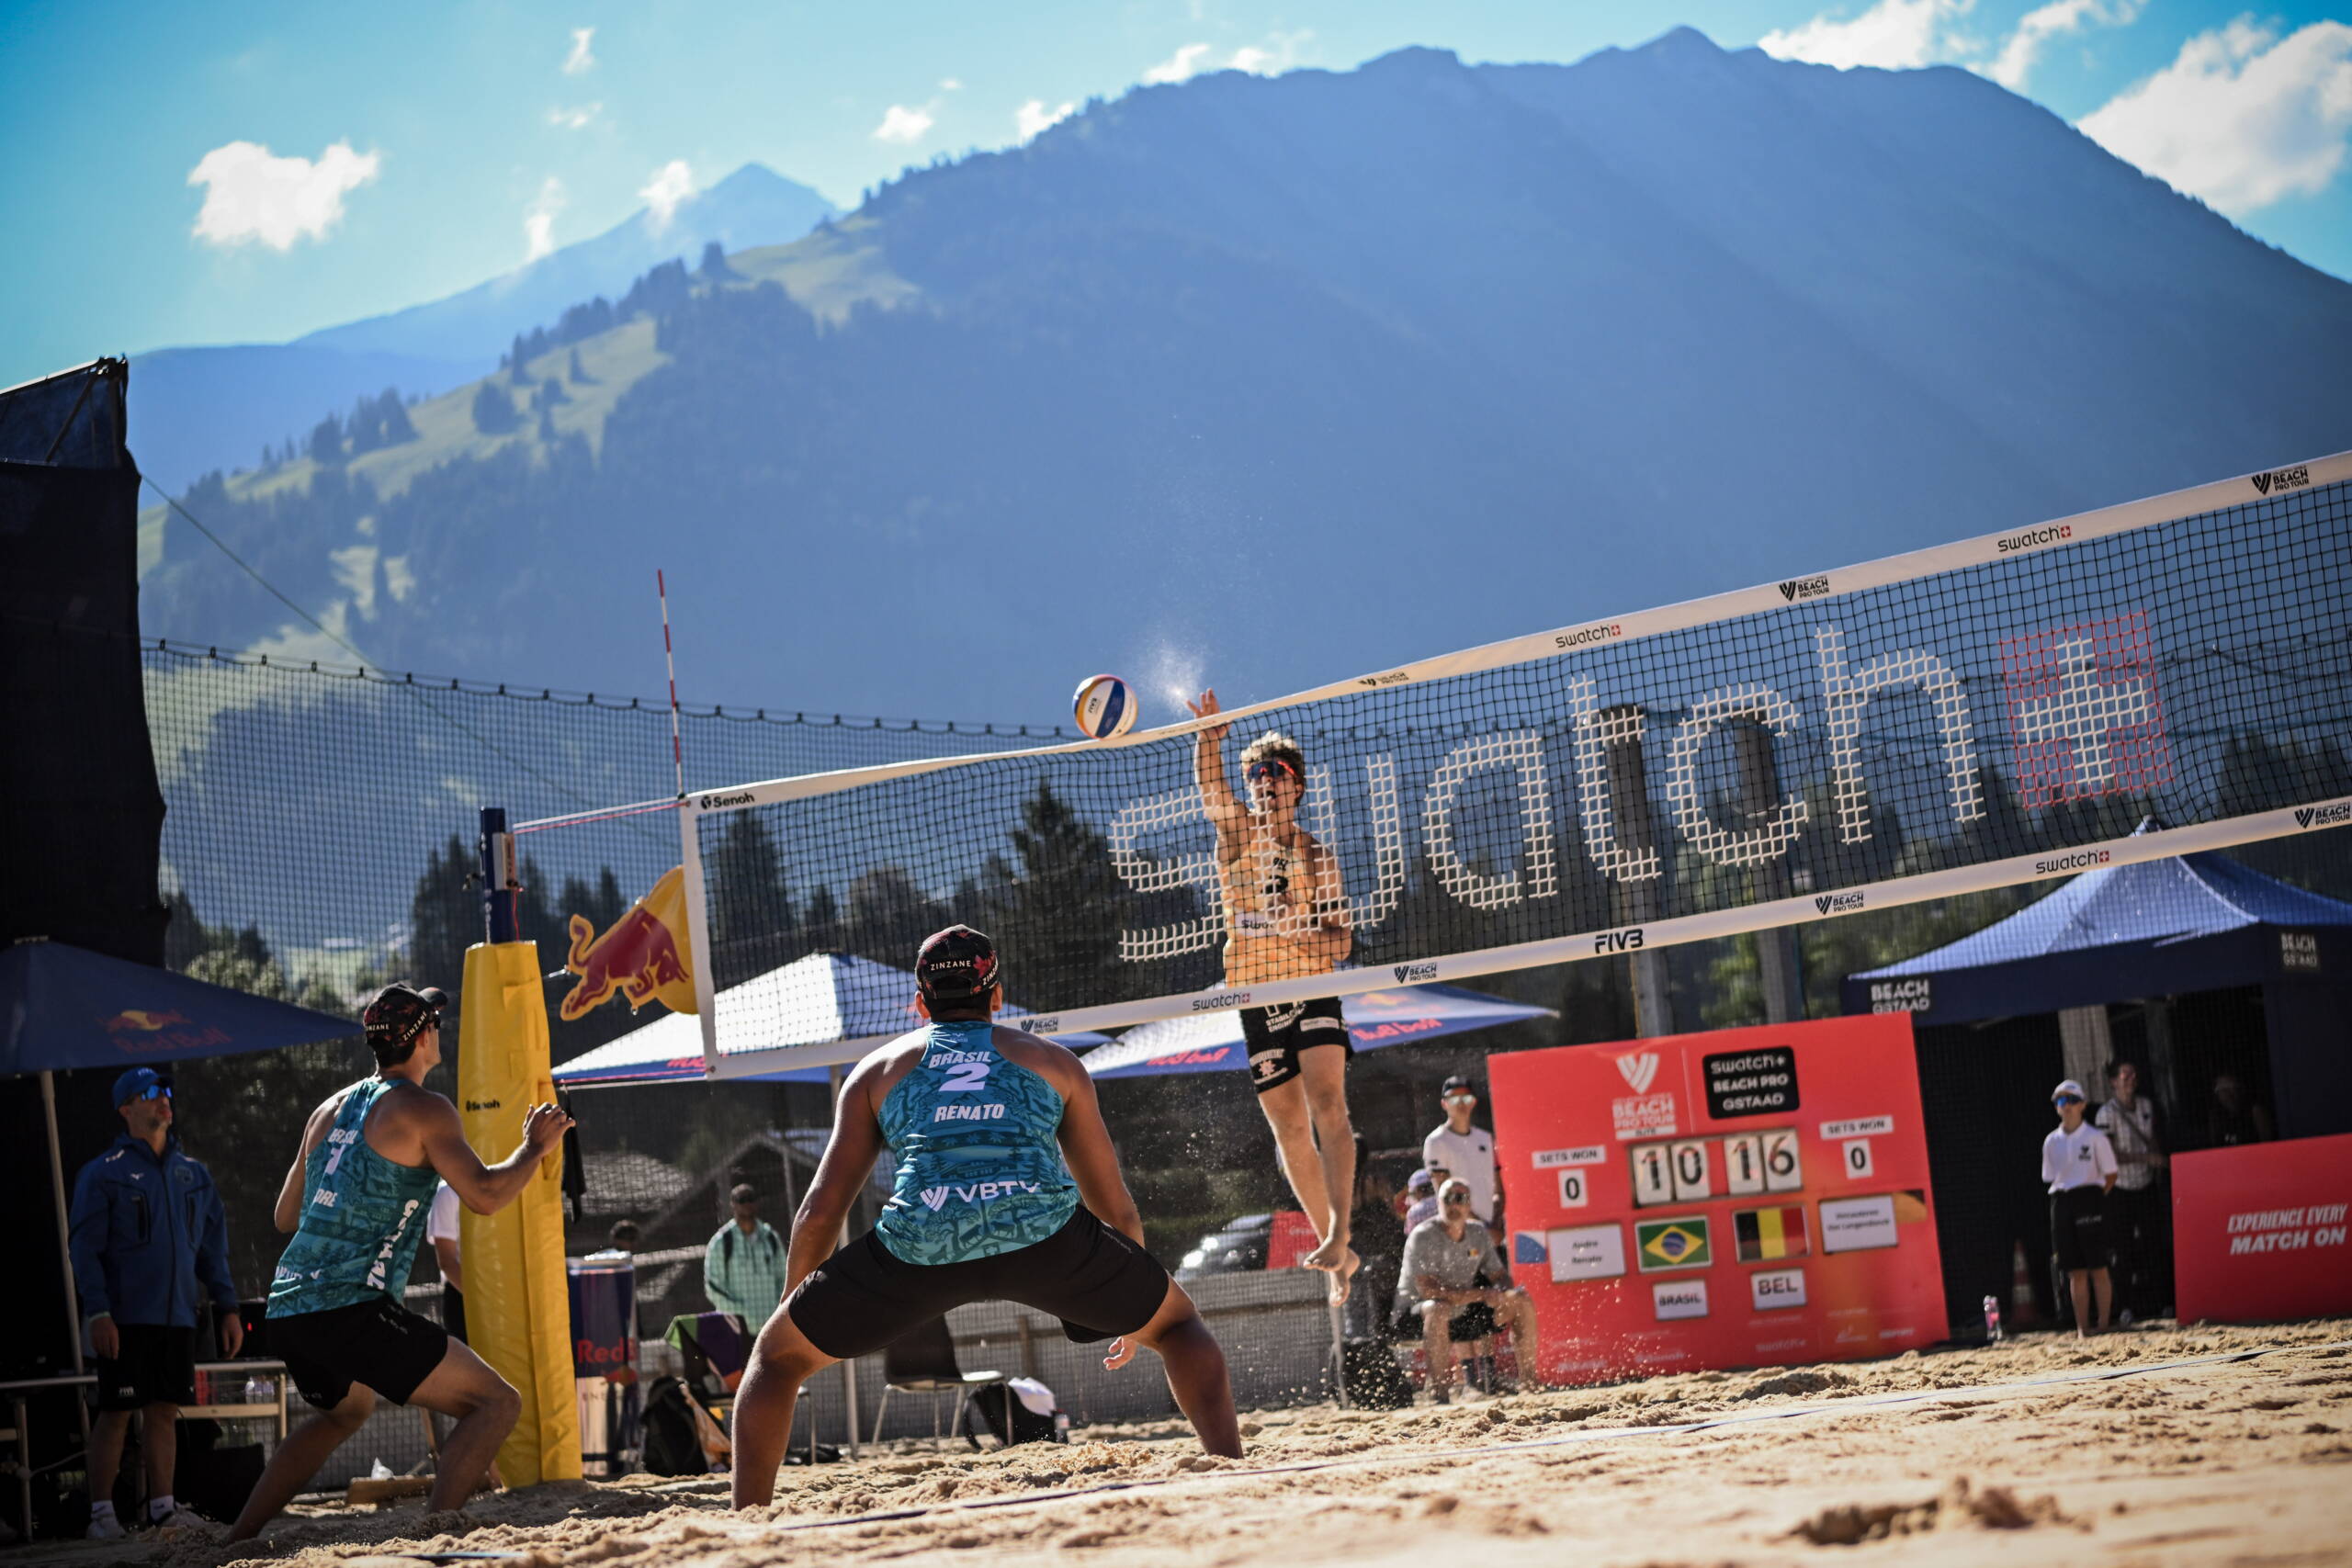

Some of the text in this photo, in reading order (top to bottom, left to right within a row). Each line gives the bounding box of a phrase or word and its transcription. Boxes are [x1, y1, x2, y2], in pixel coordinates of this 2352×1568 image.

[2273, 468, 2309, 485] BEACH
[2274, 478, 2310, 491] PRO TOUR
[1997, 526, 2060, 553] swatch
[1797, 578, 1828, 592] BEACH
[1814, 587, 1830, 596] TOUR
[1555, 625, 1611, 649] swatch
[713, 792, 755, 807] Senoh
[2315, 805, 2350, 819] BEACH
[2036, 850, 2098, 874] swatch
[1832, 893, 1864, 907] BEACH
[1595, 928, 1644, 954] FIVB
[931, 960, 972, 971] ZINZANE
[1409, 964, 1437, 976] BEACH
[1871, 979, 1929, 1001] BEACH
[1192, 993, 1240, 1011] swatch
[928, 1051, 992, 1068] BRASIL
[1710, 1054, 1774, 1075] swatch
[938, 1062, 990, 1092] 2
[1713, 1072, 1789, 1093] BEACH PRO
[1612, 1099, 1674, 1118] BEACH
[1723, 1091, 1785, 1111] GSTAAD
[934, 1103, 1005, 1122] RENATO
[1829, 1117, 1886, 1134] SETS WON
[1571, 1149, 1598, 1160] WON
[1849, 1146, 1866, 1170] 0
[1565, 1177, 1580, 1201] 0
[2227, 1202, 2348, 1234] EXPERIENCE EVERY
[2230, 1225, 2347, 1256] MATCH ON
[1758, 1276, 1799, 1296] BEL
[1659, 1293, 1702, 1307] BRASIL
[577, 1337, 624, 1364] Red
